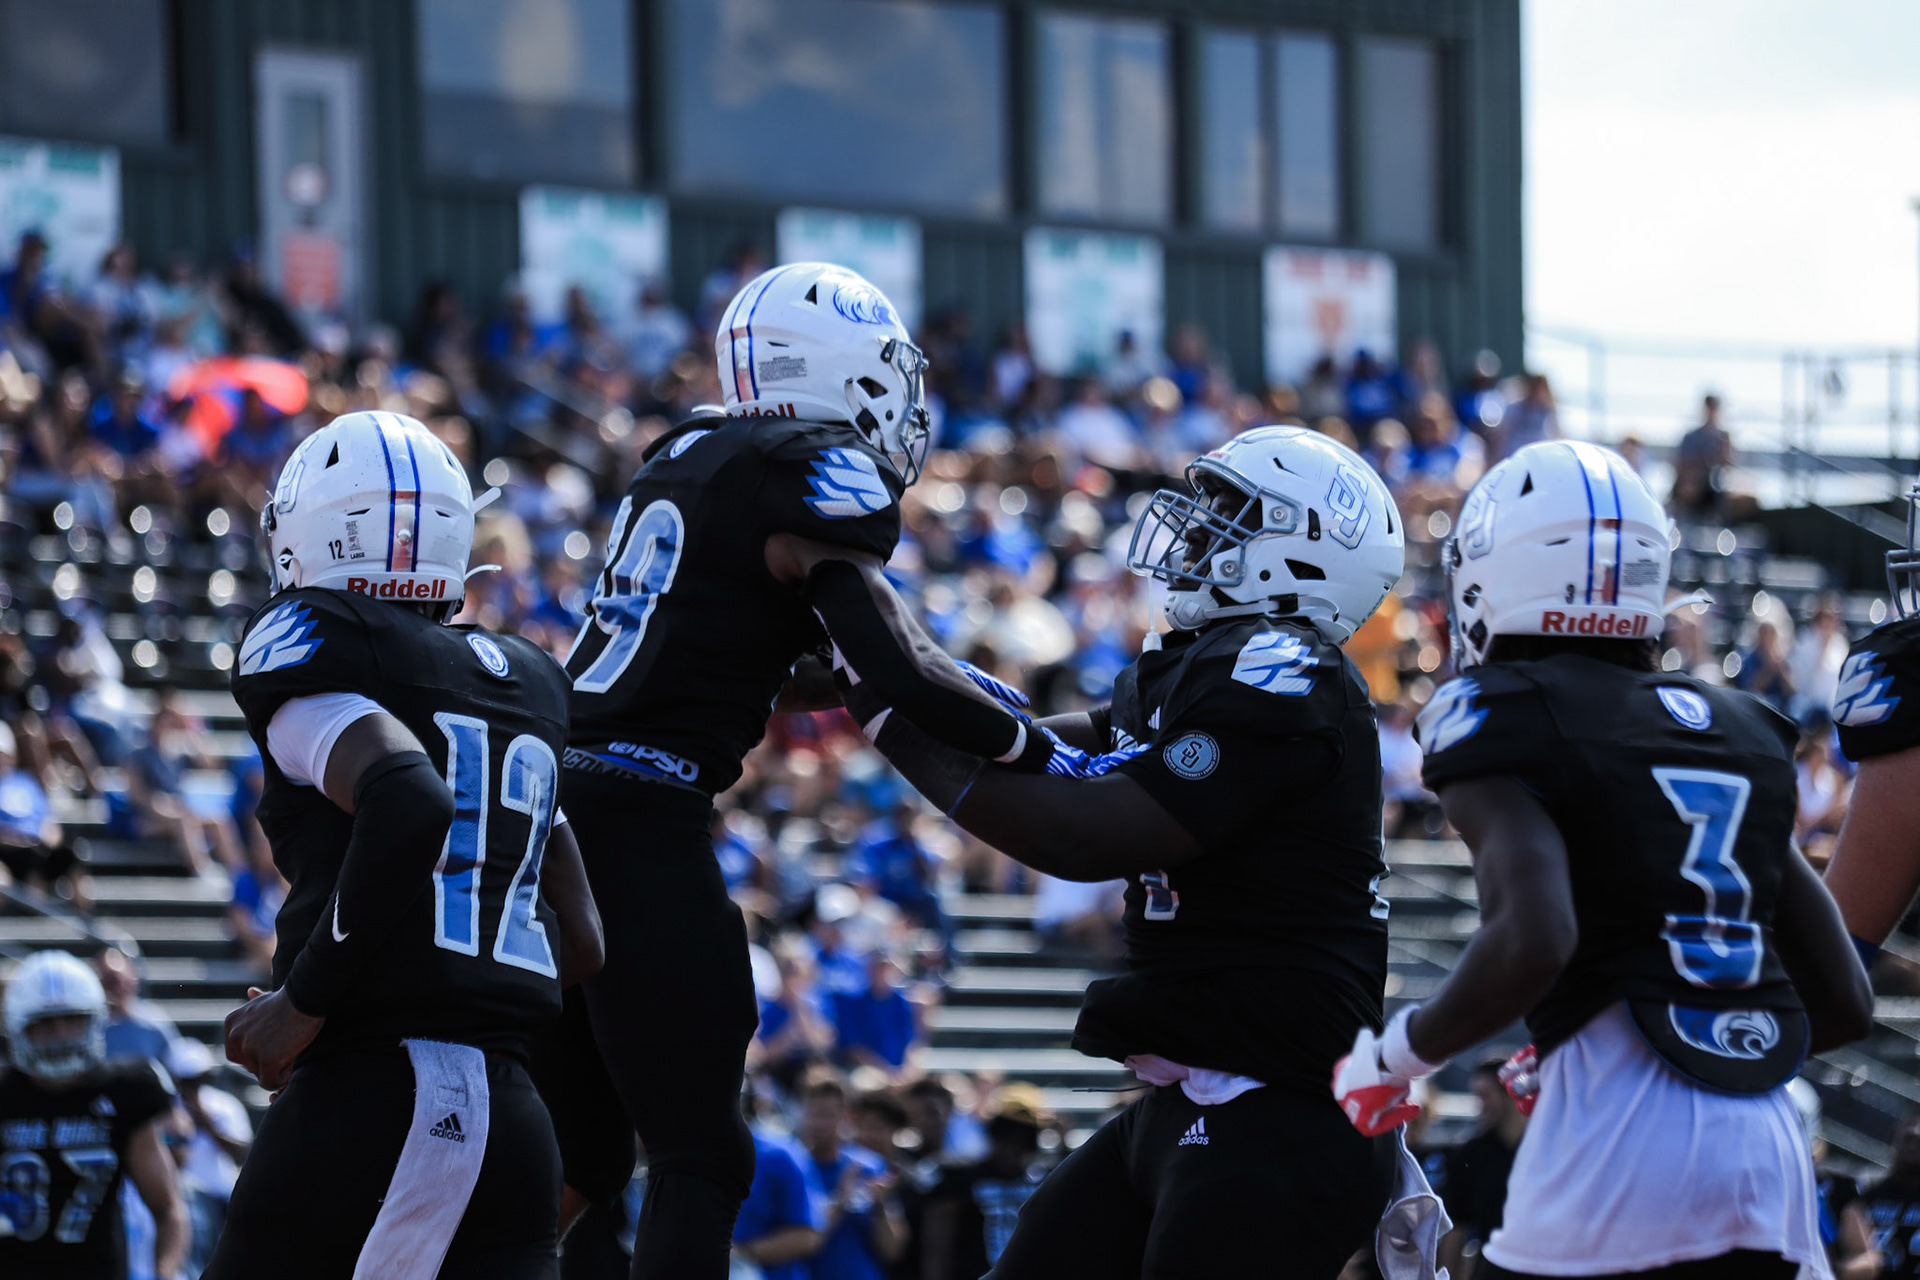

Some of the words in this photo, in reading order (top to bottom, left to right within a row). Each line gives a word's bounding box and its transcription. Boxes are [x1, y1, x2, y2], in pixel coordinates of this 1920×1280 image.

[328, 539, 345, 560] 12
[347, 577, 446, 599] Riddell
[1564, 583, 1576, 605] 3
[1541, 611, 1648, 636] Riddell
[631, 744, 700, 783] PSD
[433, 711, 559, 979] 12
[1651, 765, 1764, 990] 3
[429, 1127, 466, 1143] adidas
[1178, 1134, 1210, 1146] adidas
